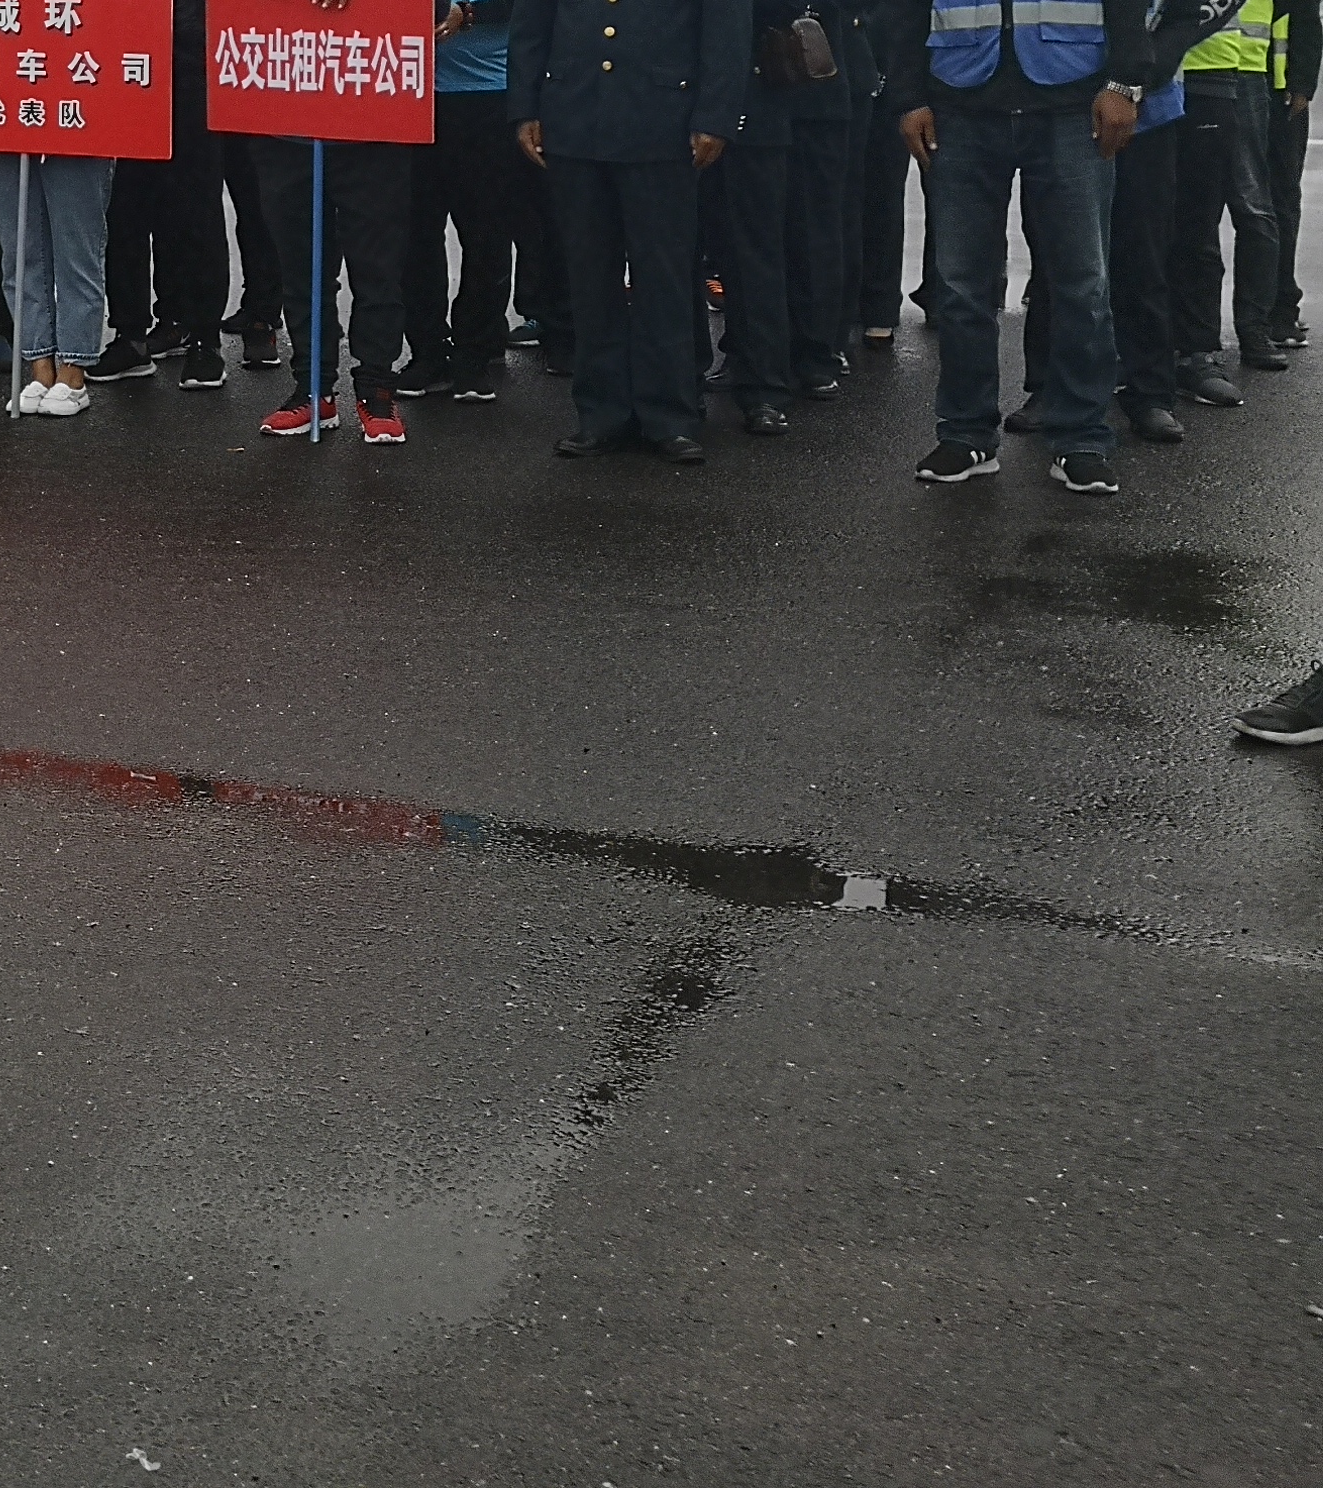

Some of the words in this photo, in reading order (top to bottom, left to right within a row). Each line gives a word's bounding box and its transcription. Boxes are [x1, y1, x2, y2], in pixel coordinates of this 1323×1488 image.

[215, 26, 425, 99] 公交出租汽车公司
